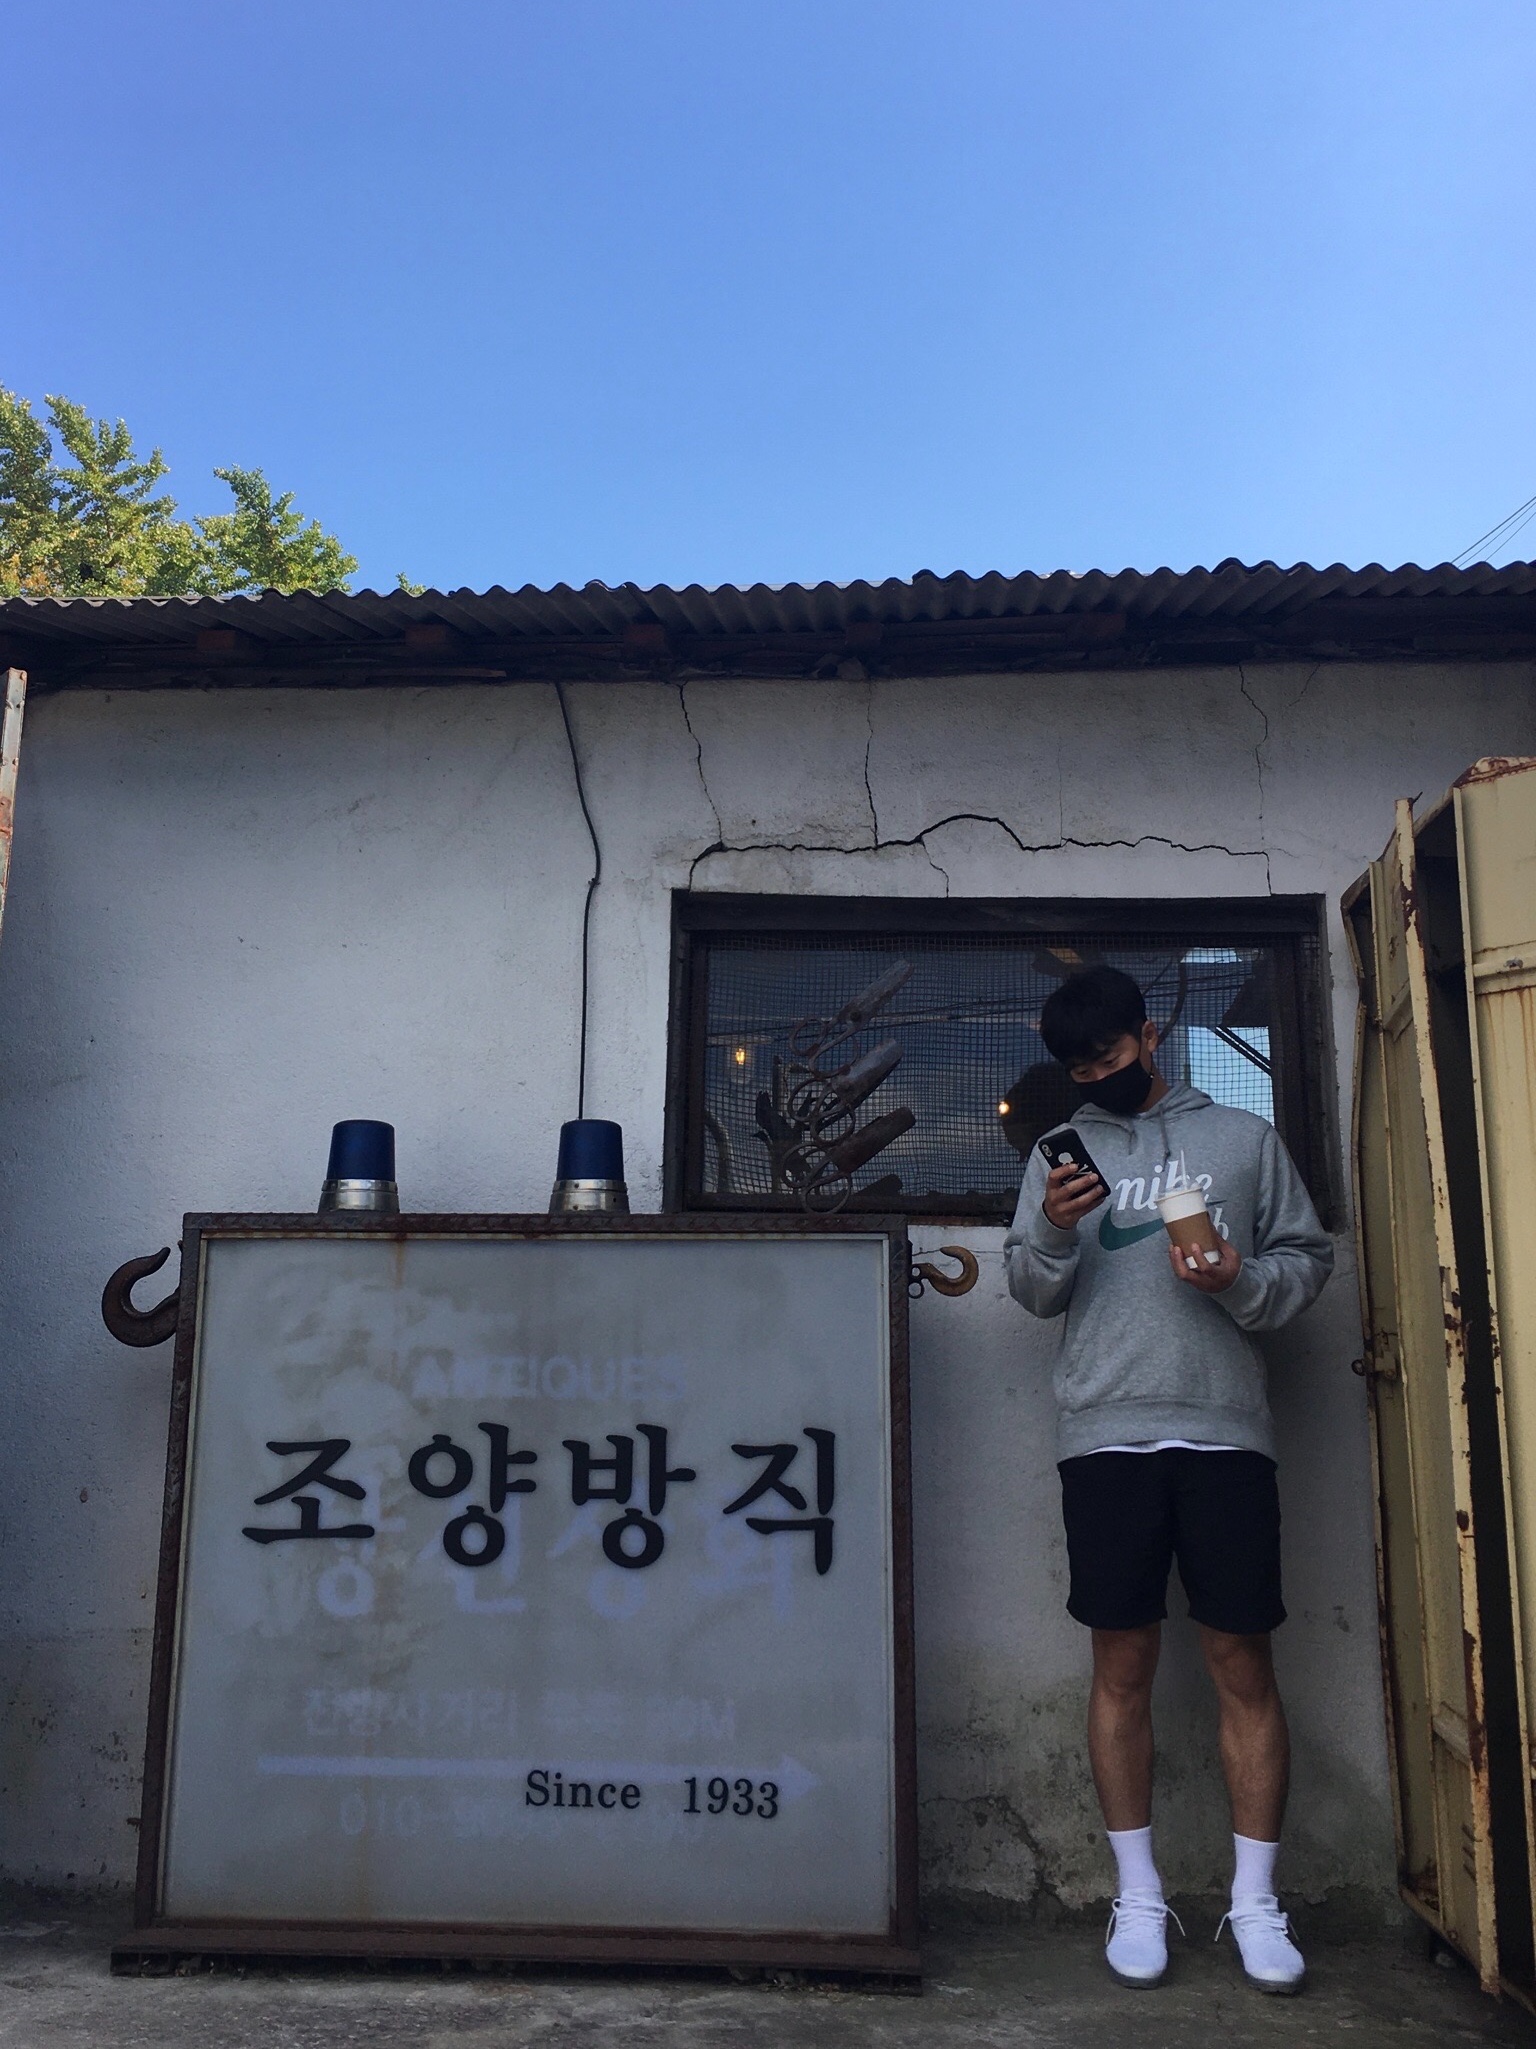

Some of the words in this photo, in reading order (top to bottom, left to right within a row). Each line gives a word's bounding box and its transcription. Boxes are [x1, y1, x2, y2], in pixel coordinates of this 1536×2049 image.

[241, 1421, 836, 1577] 조양방직
[525, 1769, 641, 1810] Since
[683, 1776, 780, 1820] 1933
